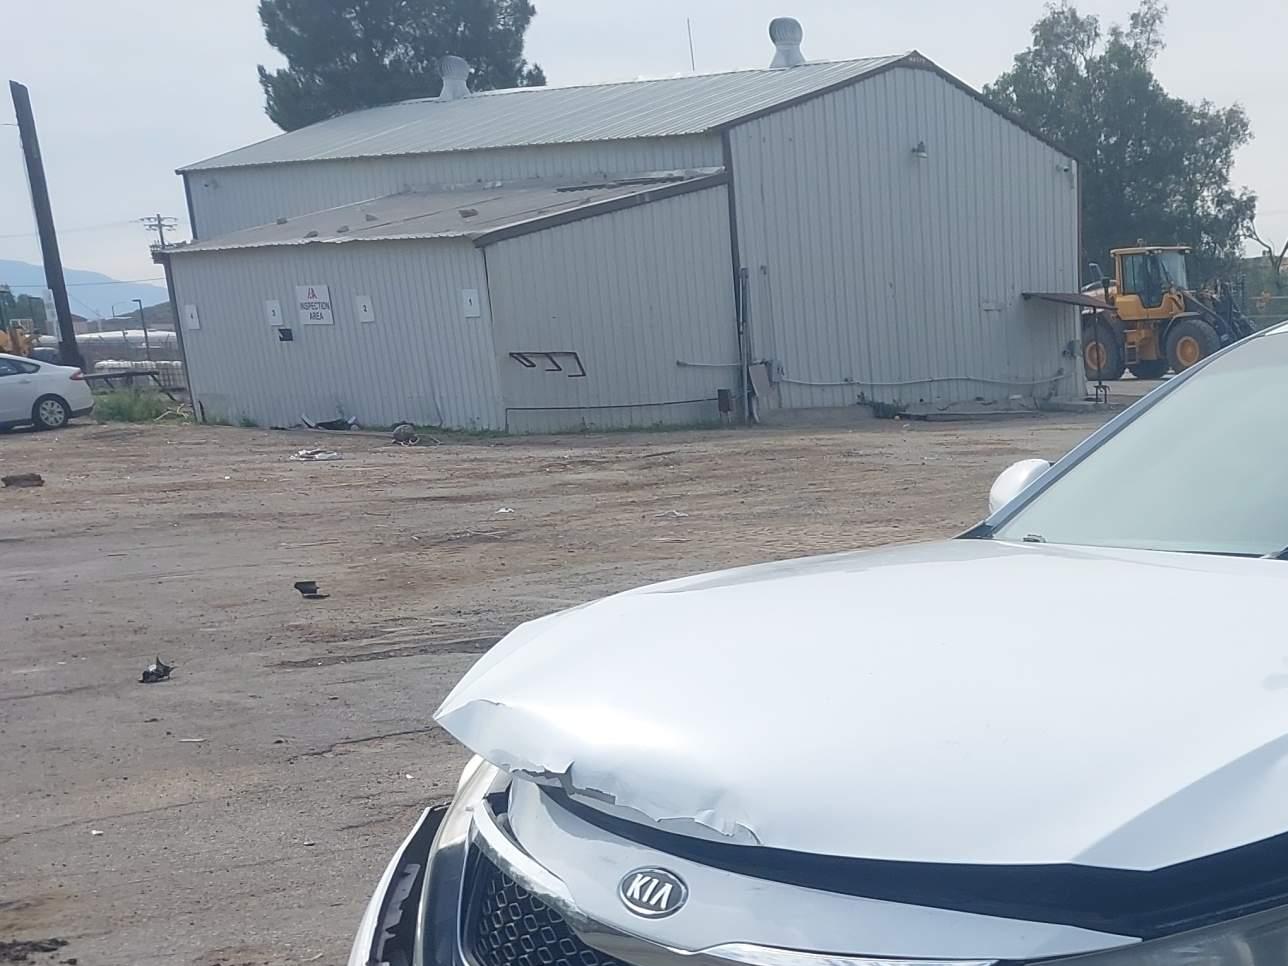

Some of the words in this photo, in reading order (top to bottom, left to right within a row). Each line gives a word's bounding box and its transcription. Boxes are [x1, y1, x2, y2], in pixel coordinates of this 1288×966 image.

[300, 301, 330, 310] INSPECTION
[309, 312, 324, 320] AREA
[626, 873, 673, 910] KIA
